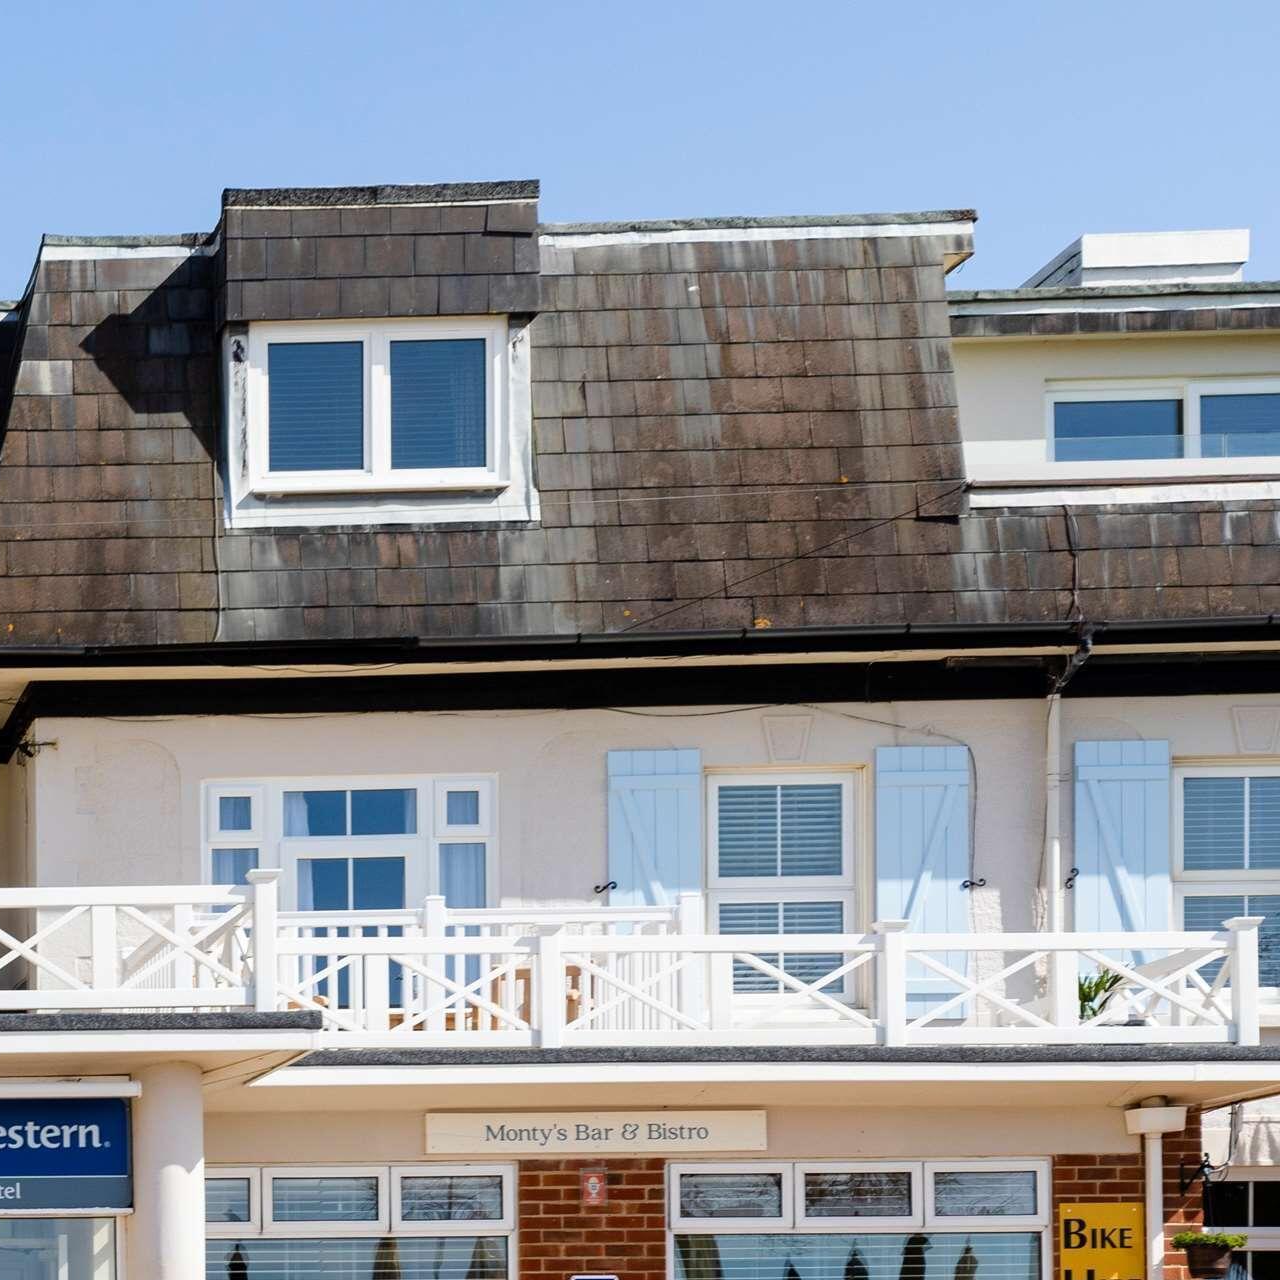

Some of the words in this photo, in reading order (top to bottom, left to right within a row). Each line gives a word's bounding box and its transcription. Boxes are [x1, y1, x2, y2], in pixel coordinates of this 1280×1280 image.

[485, 1123, 568, 1146] Monty's
[574, 1124, 614, 1142] Bar
[621, 1123, 640, 1141] &
[646, 1122, 710, 1141] Bistro
